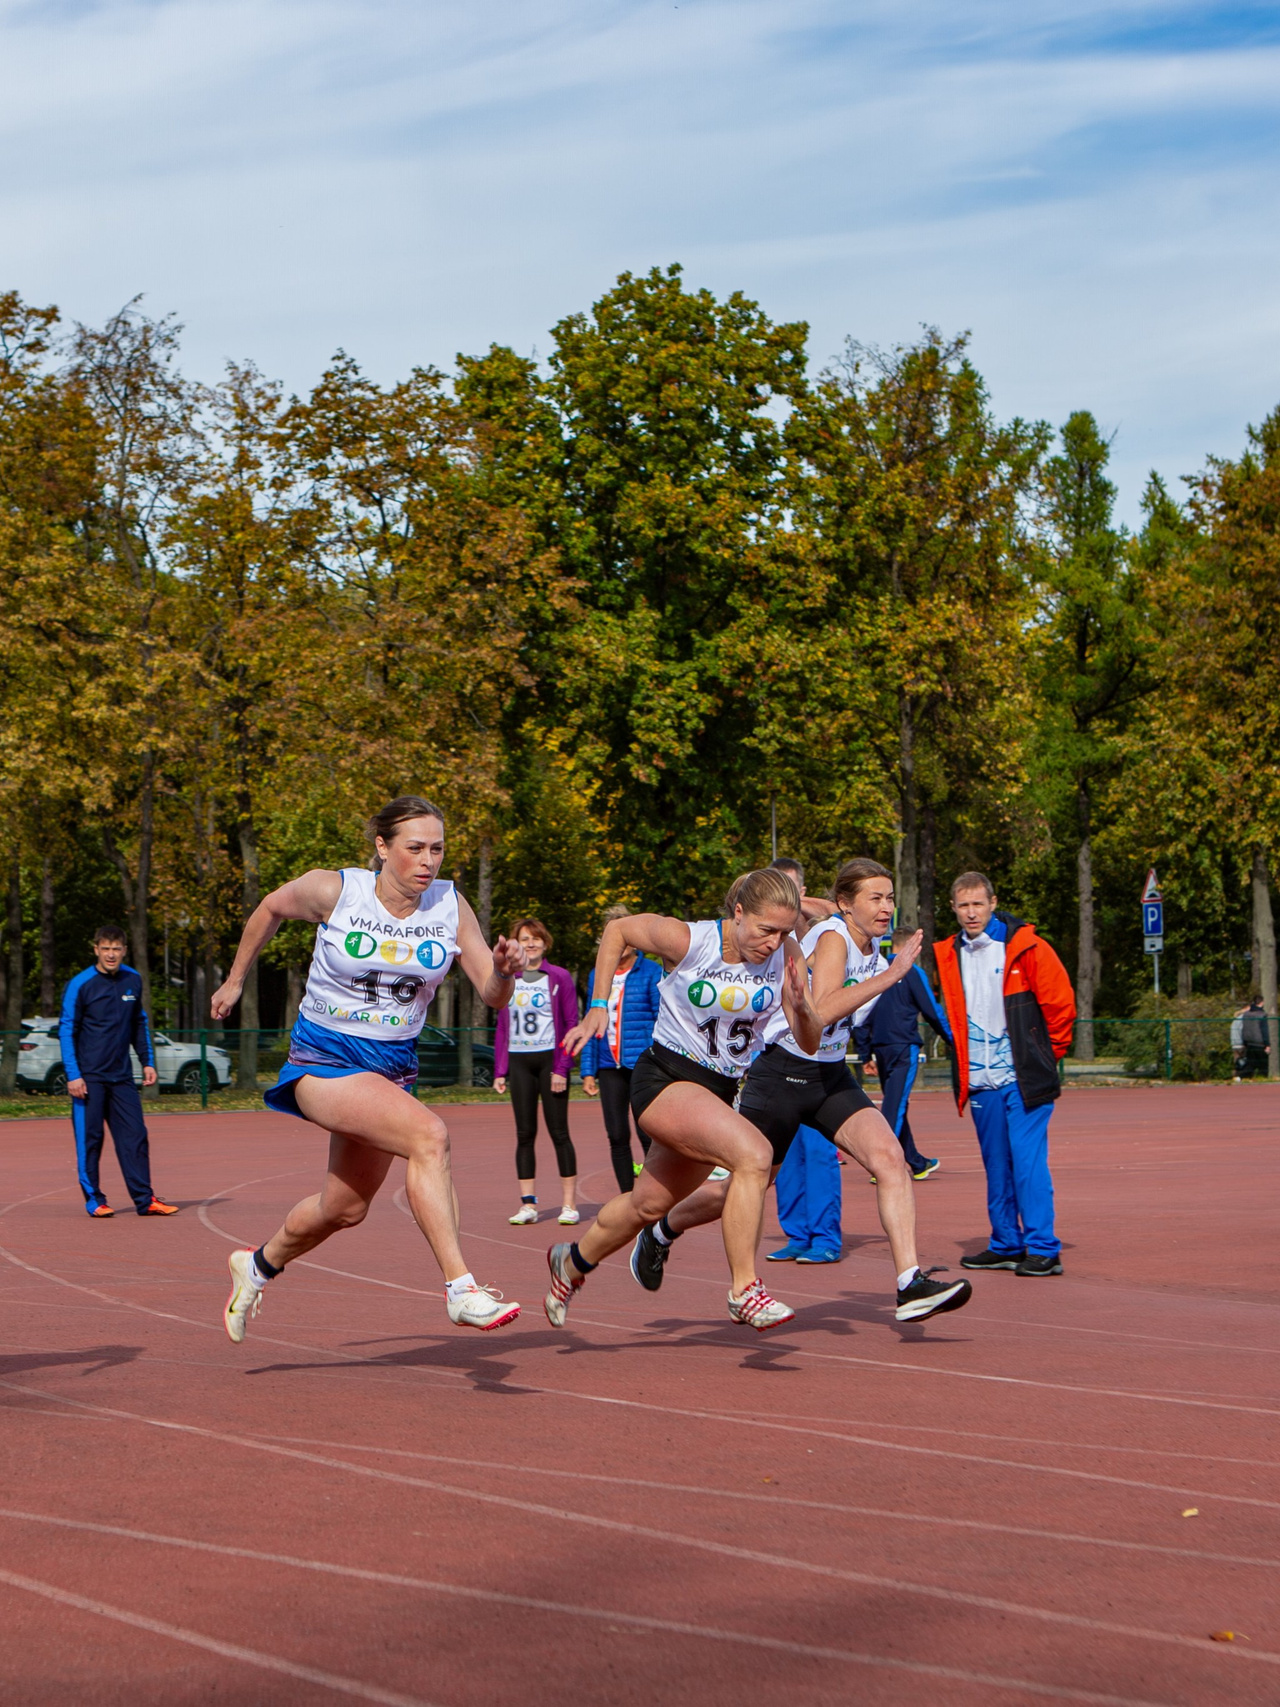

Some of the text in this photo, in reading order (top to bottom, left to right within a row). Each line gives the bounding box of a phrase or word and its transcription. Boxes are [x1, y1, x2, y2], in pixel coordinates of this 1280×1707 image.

[349, 916, 445, 938] VMARAFONE
[1148, 907, 1158, 931] P
[351, 969, 426, 1006] 16
[696, 967, 776, 985] VMARAFONE
[513, 1010, 538, 1036] 18
[697, 1016, 758, 1059] 15
